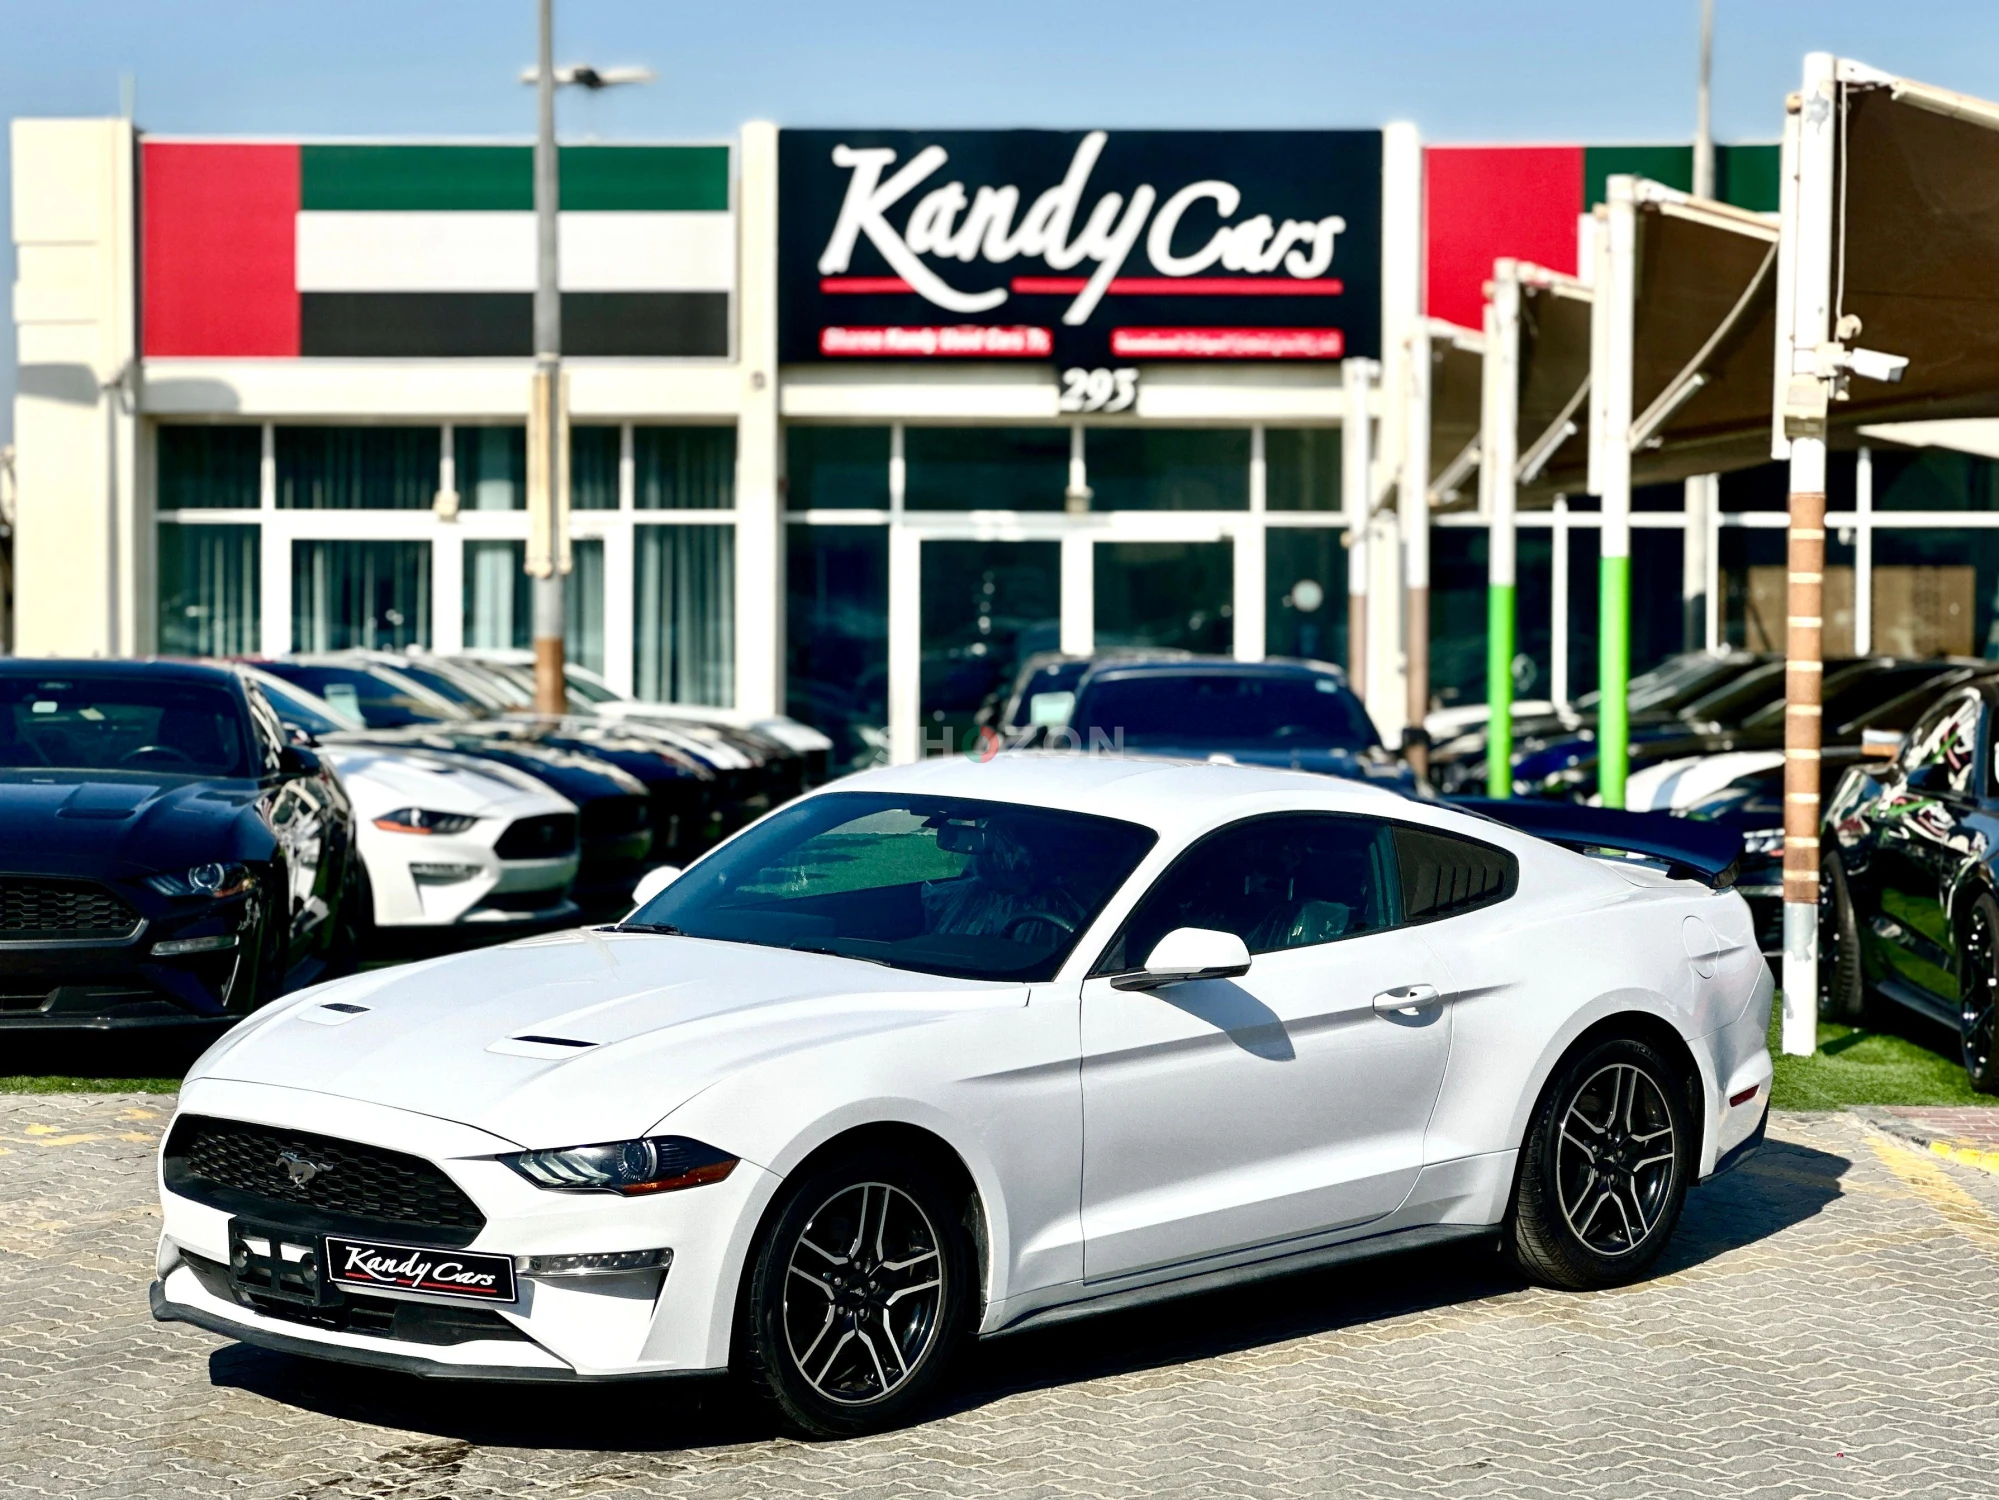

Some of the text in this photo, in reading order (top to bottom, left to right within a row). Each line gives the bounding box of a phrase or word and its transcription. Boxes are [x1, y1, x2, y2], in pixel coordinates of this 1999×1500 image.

[818, 131, 1346, 325] Kandy Cars
[1059, 367, 1140, 413] 295
[345, 1246, 496, 1287] Kandy Cars
